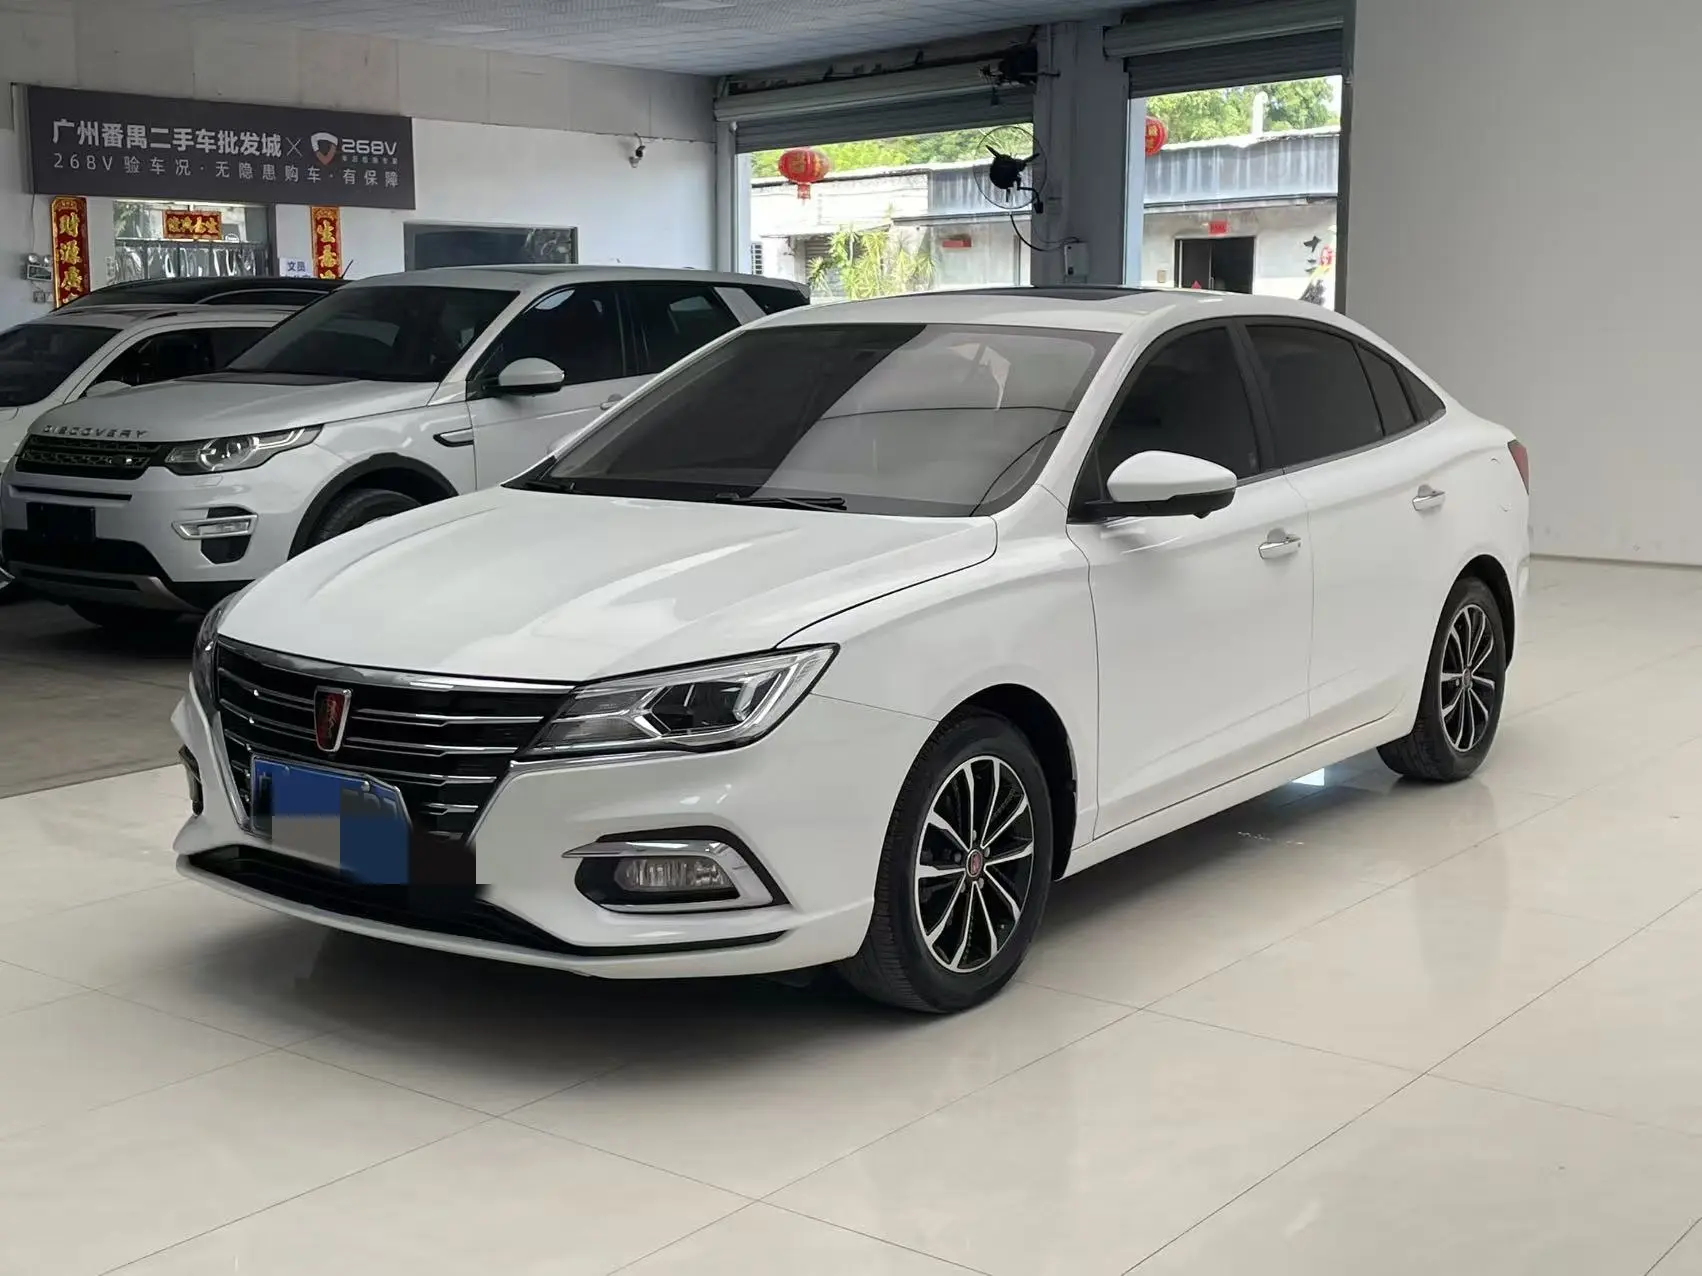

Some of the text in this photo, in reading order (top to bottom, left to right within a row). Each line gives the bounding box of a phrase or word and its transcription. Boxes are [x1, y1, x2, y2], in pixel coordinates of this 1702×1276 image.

[52, 118, 282, 158] 广州番禺二手车批发城
[43, 424, 149, 439] DISCOVERY
